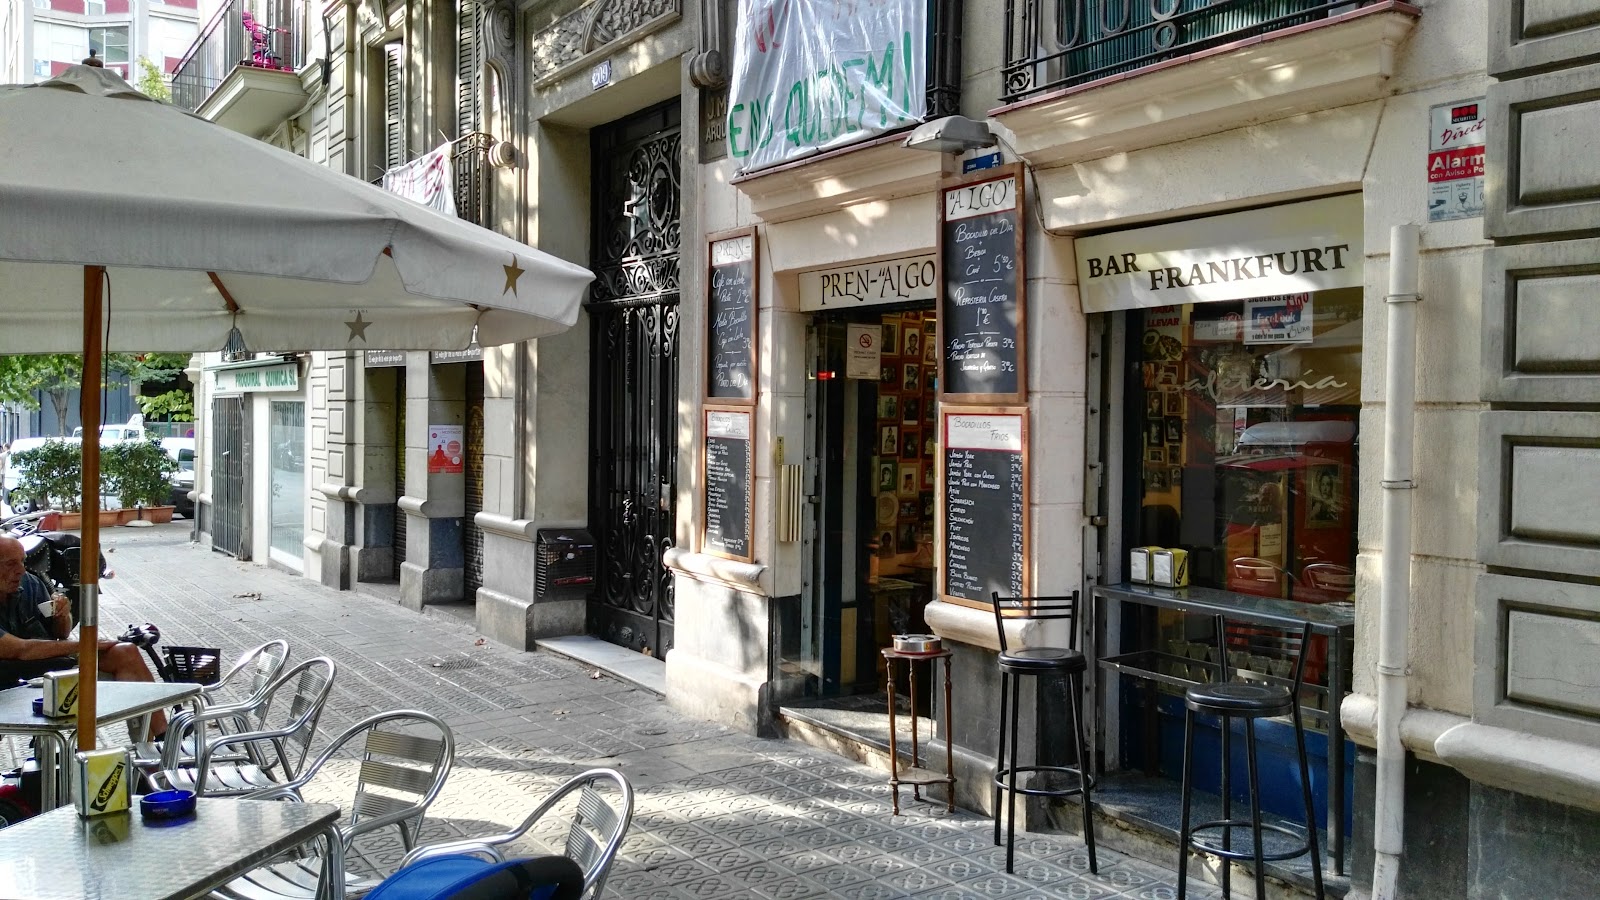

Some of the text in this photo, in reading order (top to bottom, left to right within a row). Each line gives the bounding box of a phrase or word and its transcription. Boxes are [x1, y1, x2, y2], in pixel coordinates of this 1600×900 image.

[729, 92, 774, 158] ENS
[1441, 118, 1486, 146] Direct
[1087, 252, 1141, 279] BAR
[1149, 243, 1349, 291] FRANKFURT
[1147, 317, 1180, 328] LLEVAR
[97, 764, 125, 801] Schweppes
